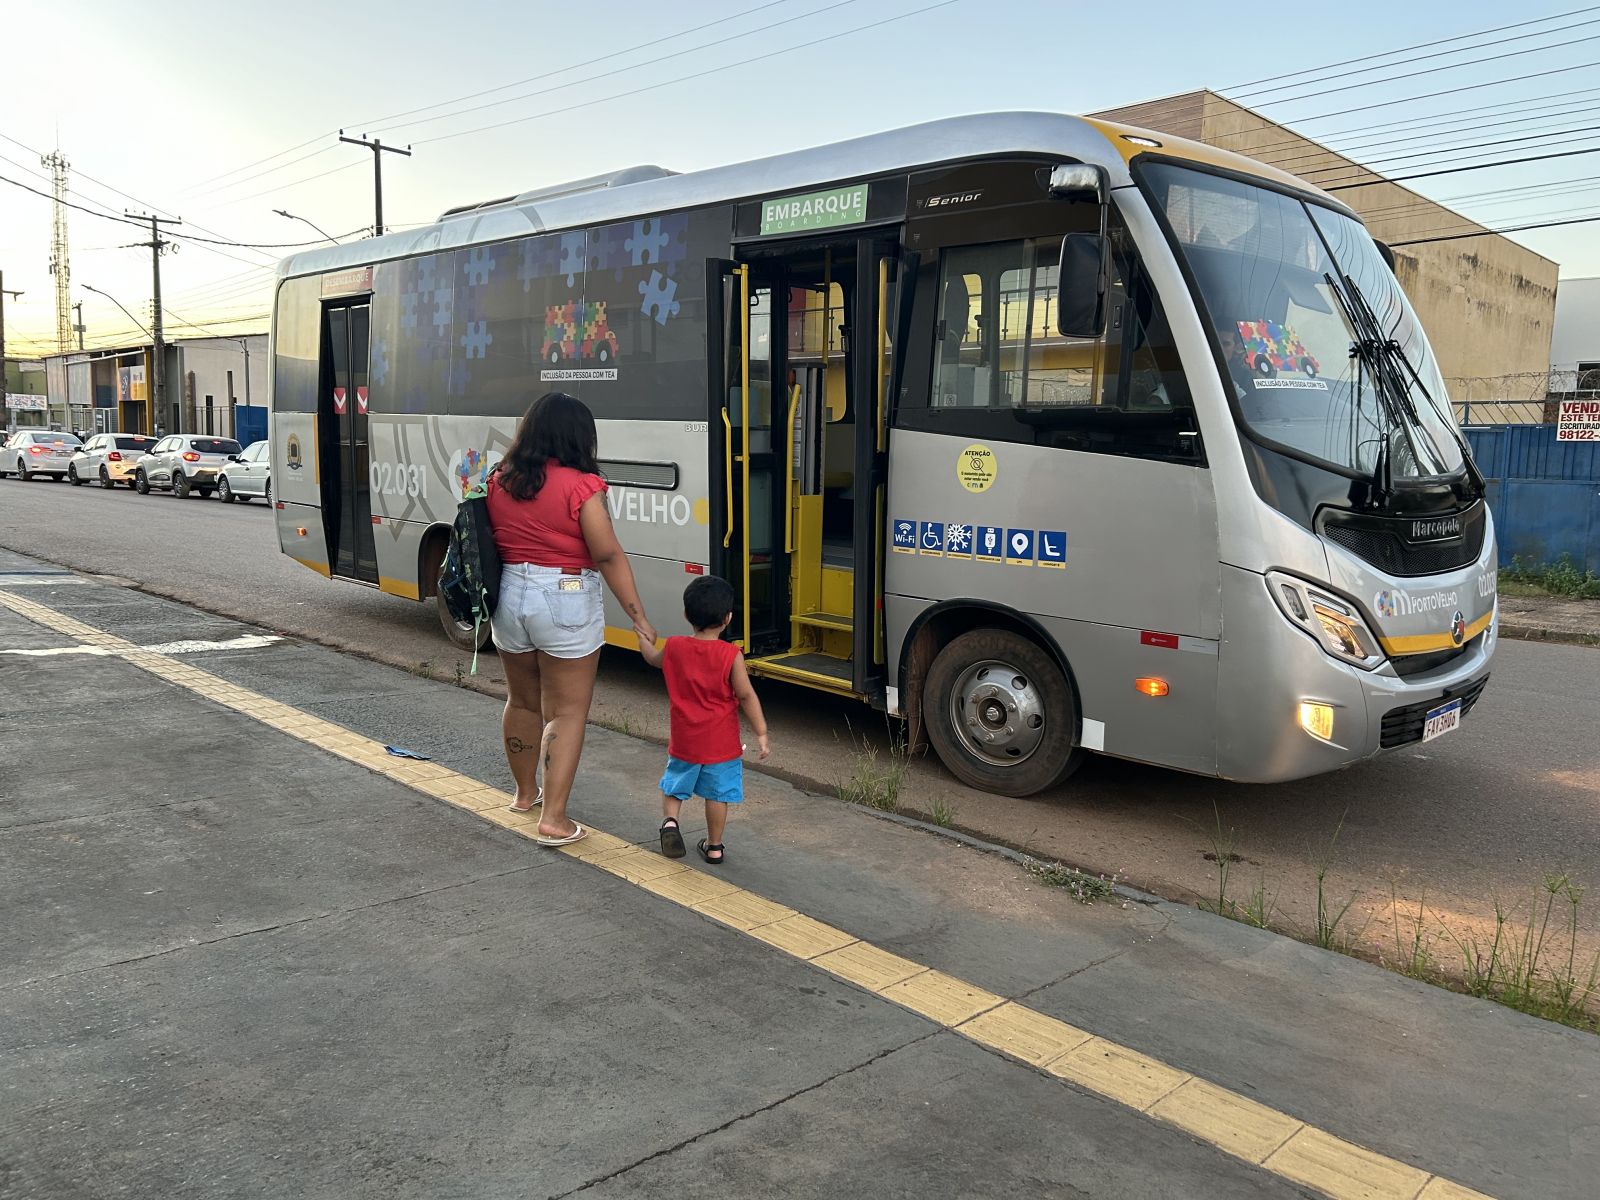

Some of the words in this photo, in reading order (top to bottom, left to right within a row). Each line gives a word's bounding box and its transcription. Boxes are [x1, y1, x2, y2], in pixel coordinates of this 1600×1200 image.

[766, 191, 862, 222] EMBARQUE
[927, 193, 982, 207] Senior
[765, 209, 861, 231] BOARDING
[542, 370, 564, 380] INCLUSÃO
[1562, 402, 1600, 414] VEND
[685, 424, 708, 432] BUR
[1560, 430, 1600, 440] 98122-
[371, 462, 427, 498] 02.031
[1412, 519, 1460, 537] Marcopolo
[895, 533, 914, 544] Wi-Fi
